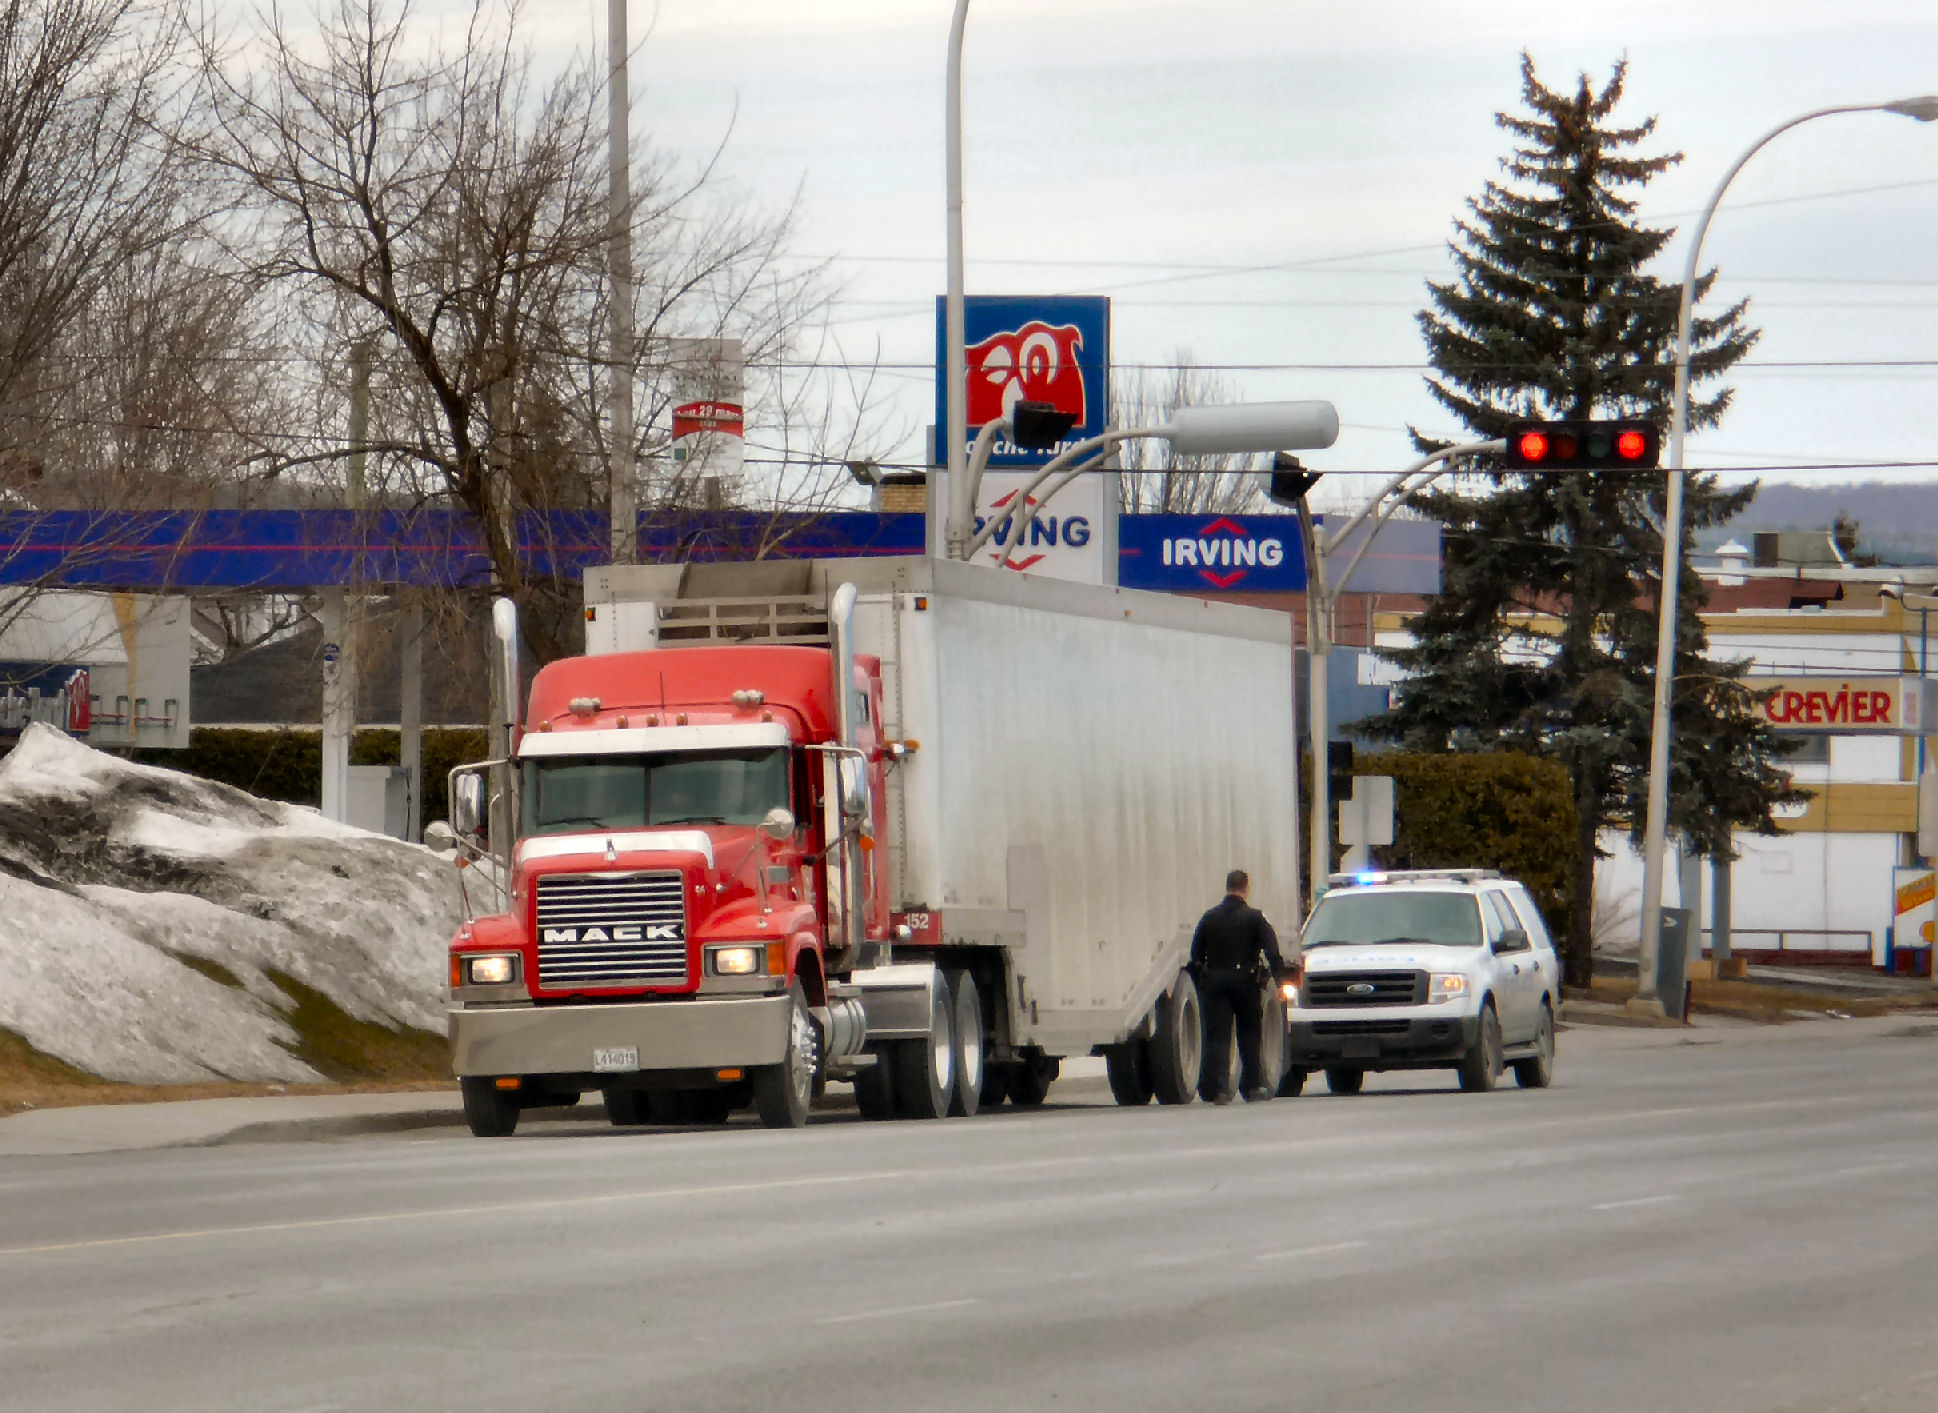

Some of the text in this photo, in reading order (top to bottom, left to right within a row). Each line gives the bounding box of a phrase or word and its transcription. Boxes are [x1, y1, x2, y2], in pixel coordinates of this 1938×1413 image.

[973, 515, 1091, 547] VNG
[1162, 538, 1284, 566] IRVING
[903, 912, 929, 929] 152
[543, 924, 678, 942] MACK
